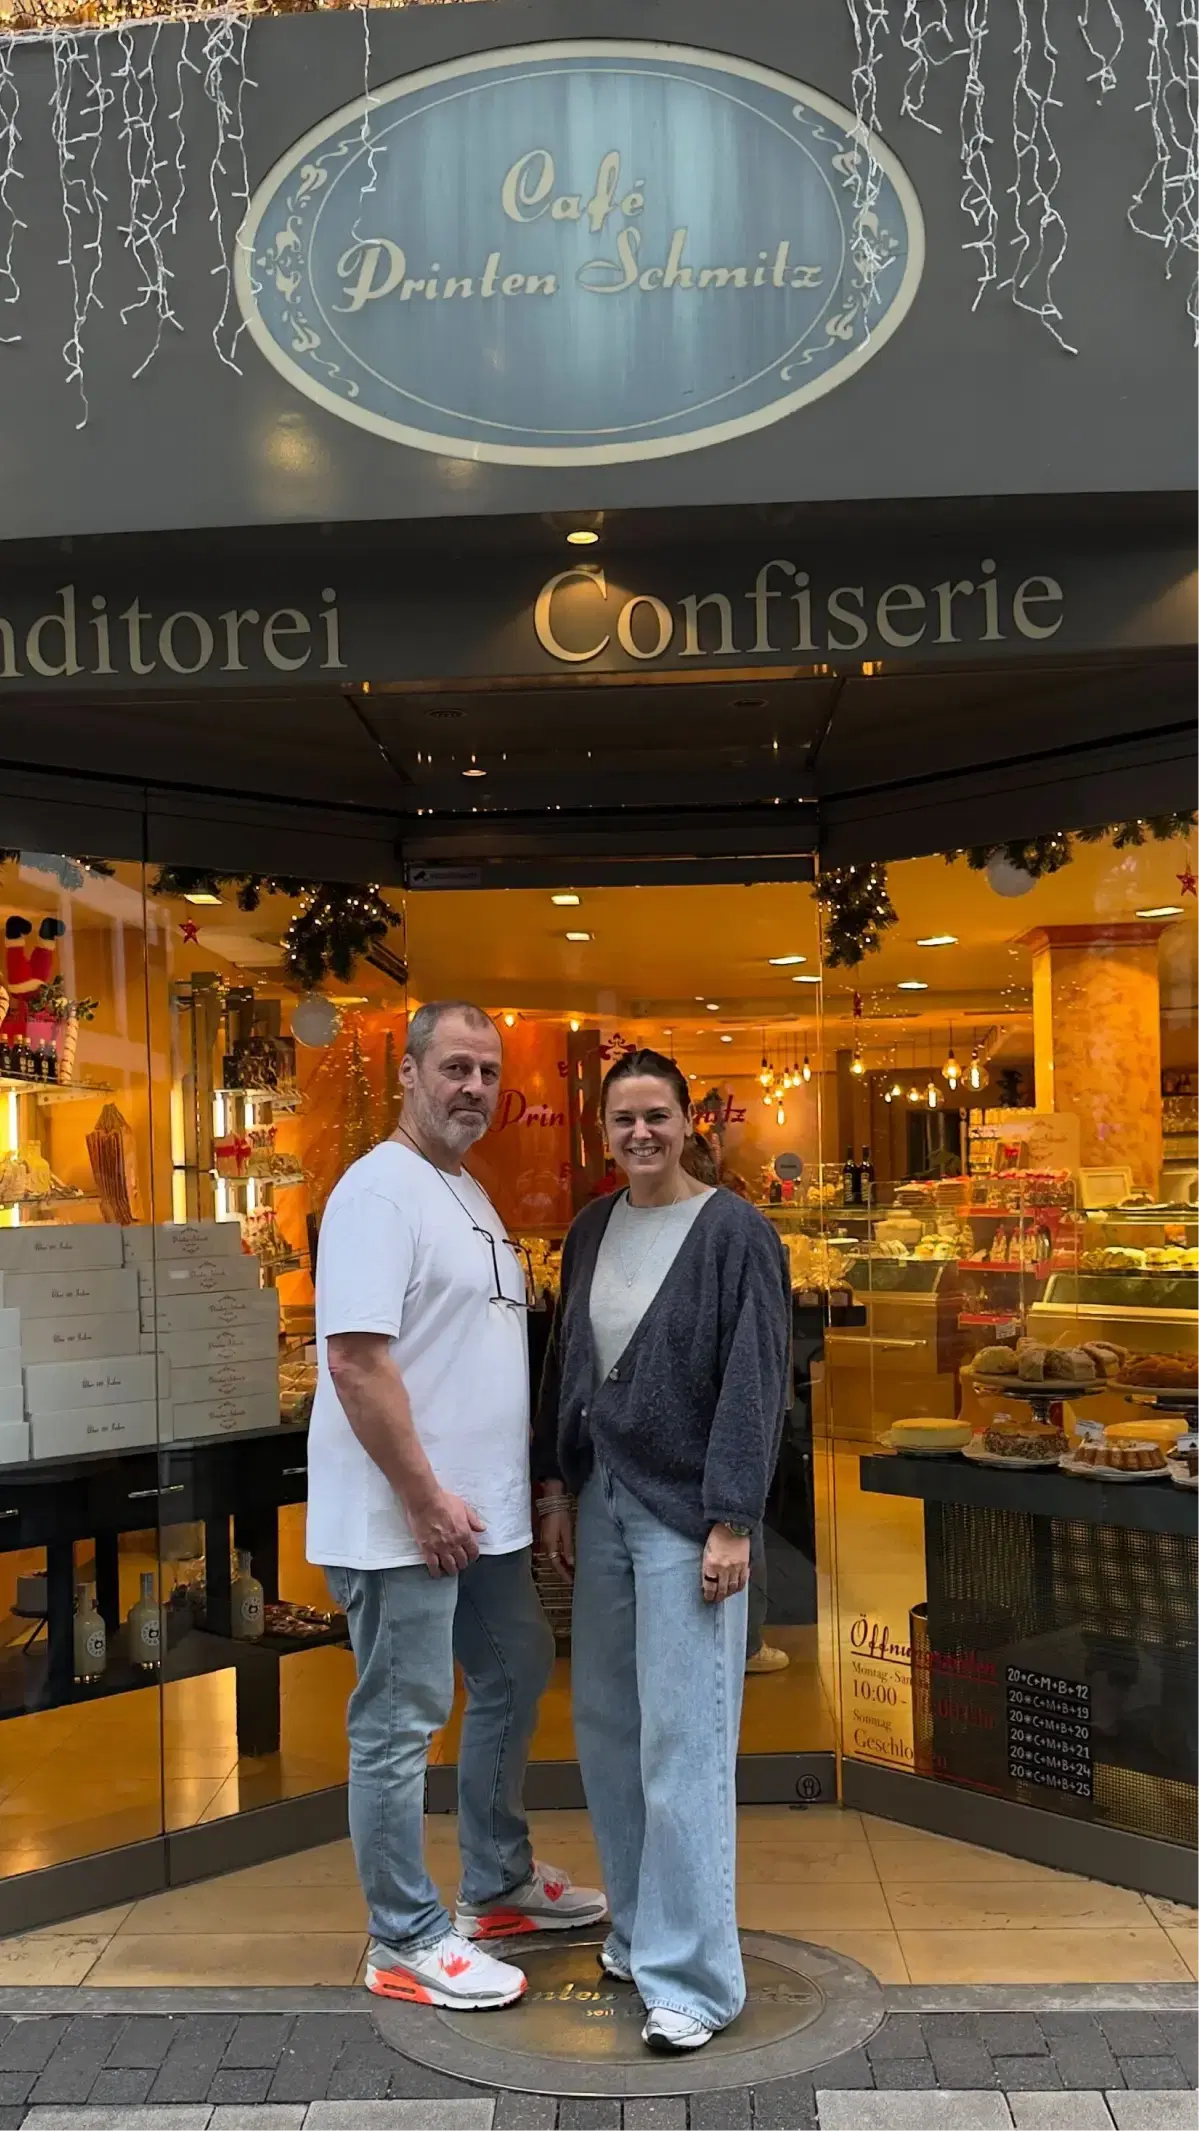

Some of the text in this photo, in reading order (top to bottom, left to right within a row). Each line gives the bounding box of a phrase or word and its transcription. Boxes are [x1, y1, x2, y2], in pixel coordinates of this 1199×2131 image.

[502, 149, 646, 233] Café
[332, 226, 825, 314] Printen Schmitz
[533, 559, 1064, 662] Confiserie
[488, 1089, 572, 1132] Prin
[852, 1661, 888, 1683] Montag
[853, 1679, 897, 1706] 10:00
[853, 1709, 893, 1731] Sonntag
